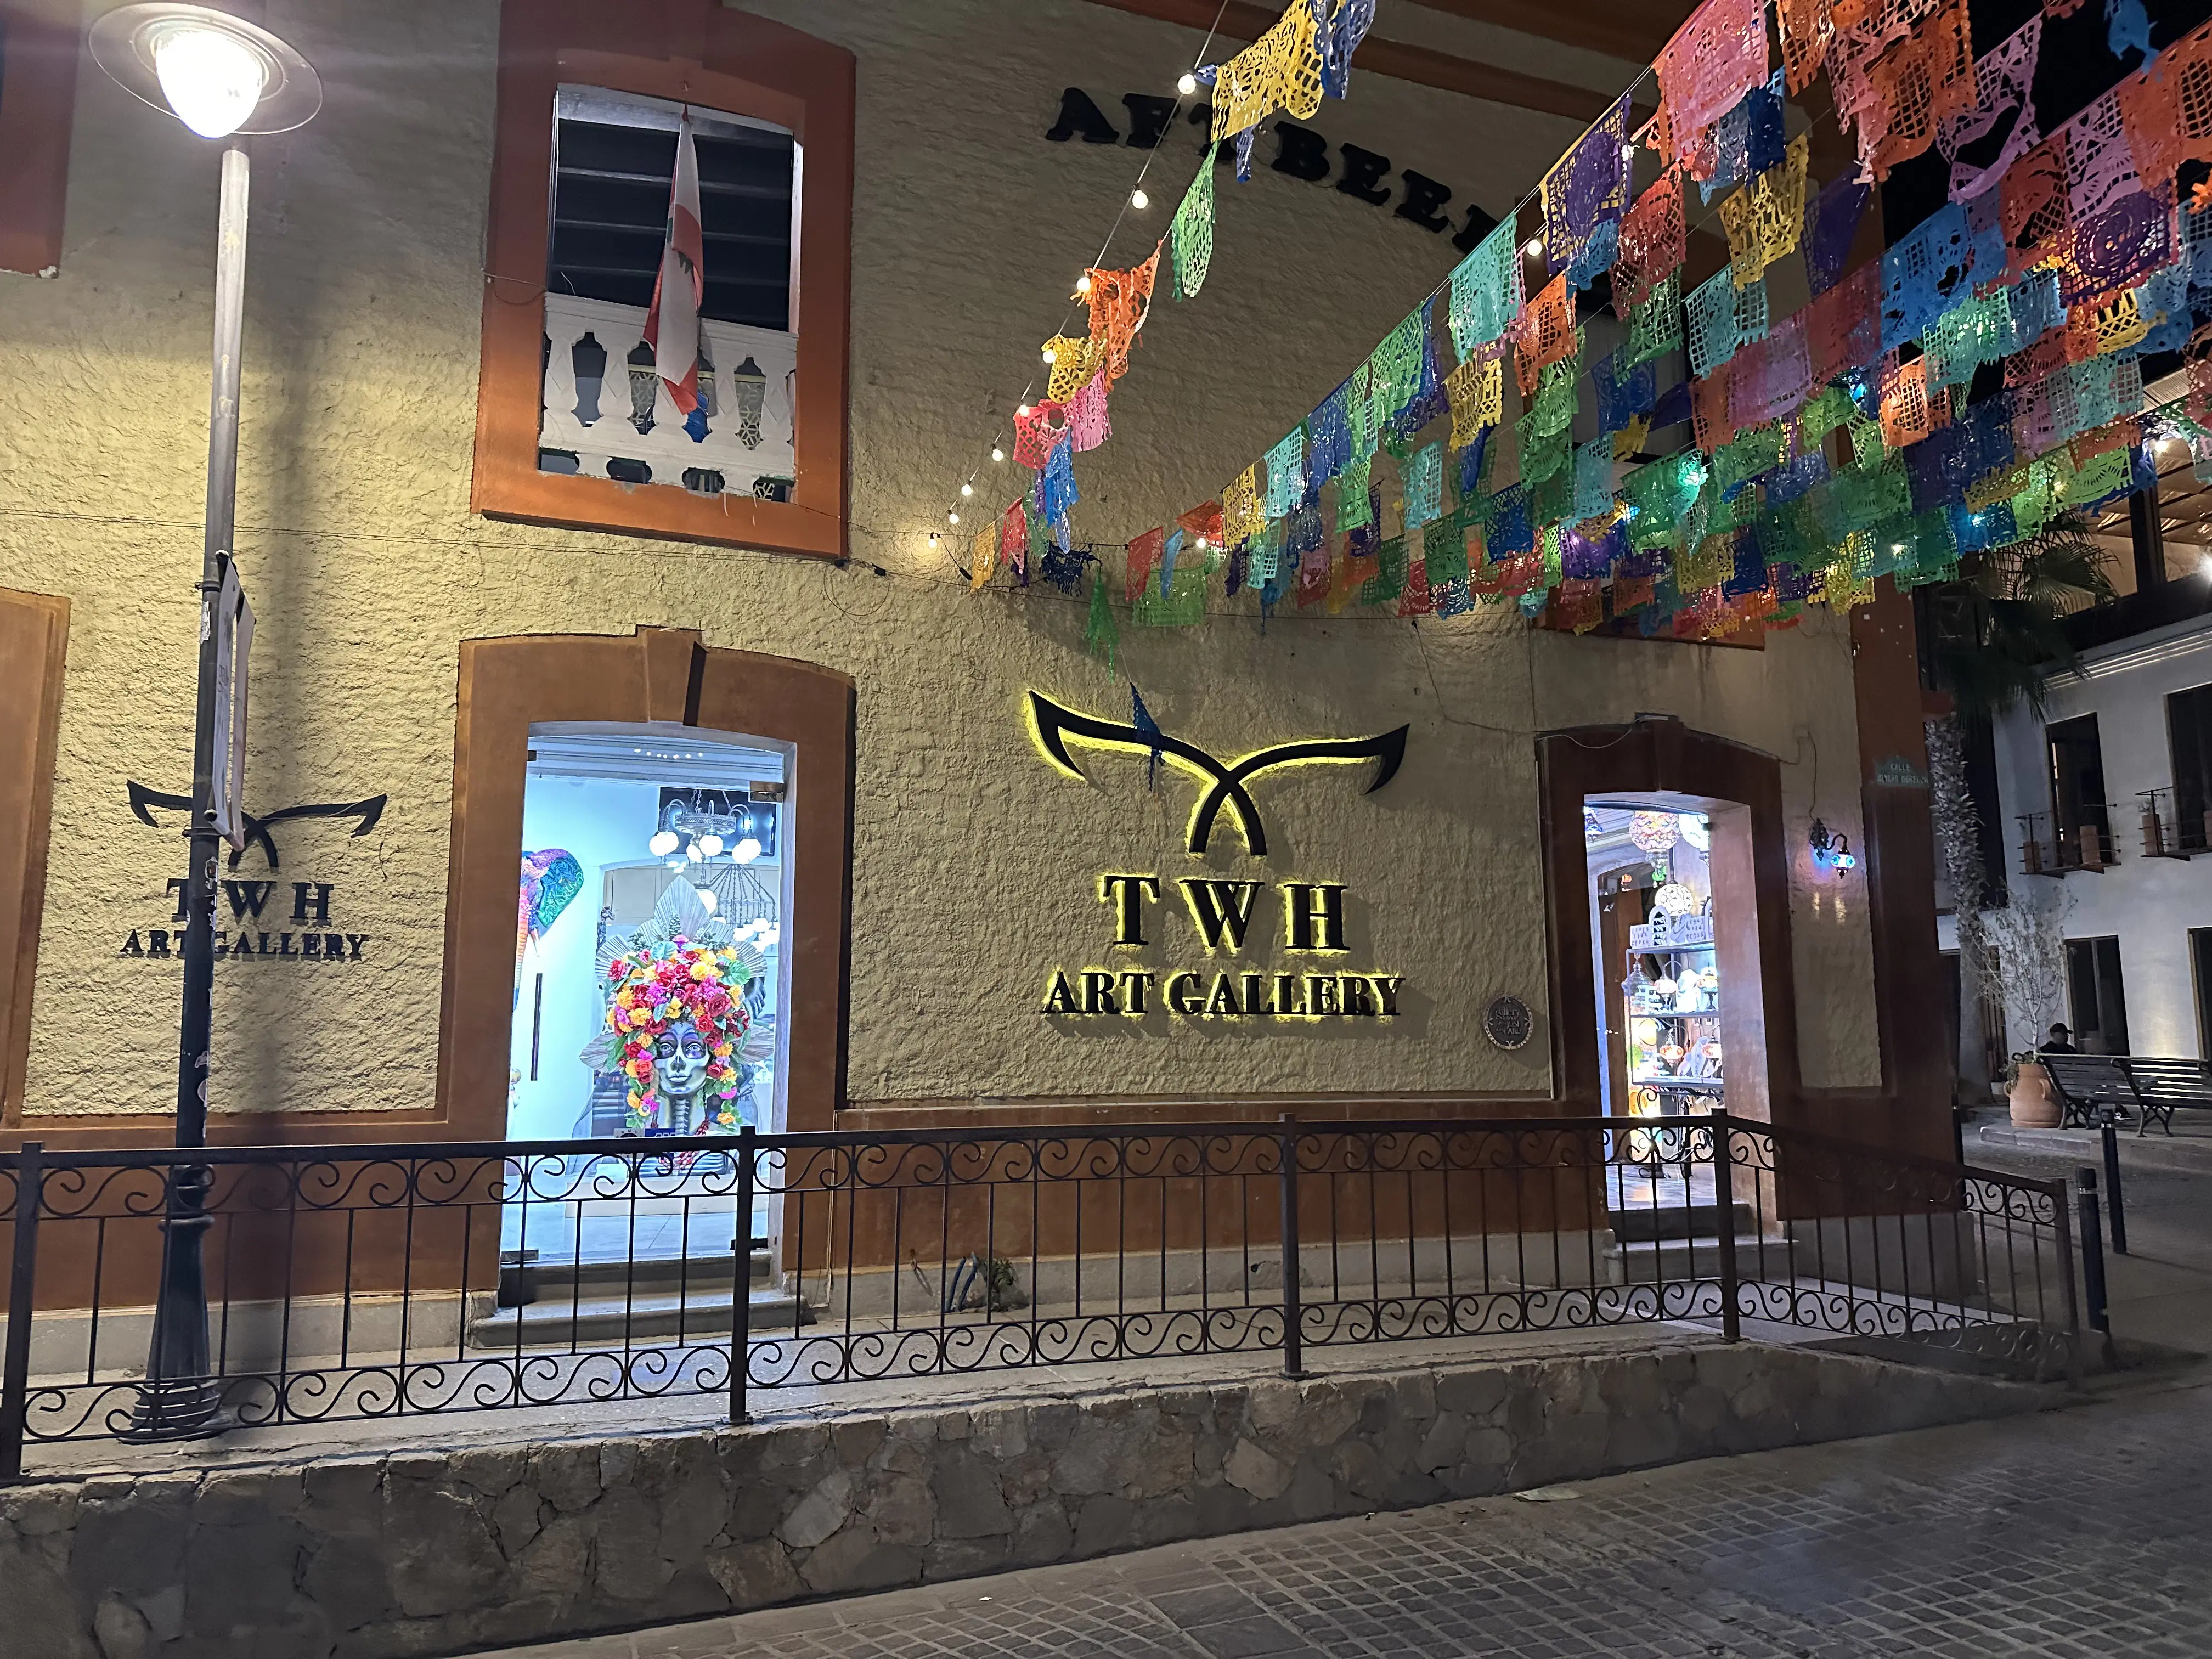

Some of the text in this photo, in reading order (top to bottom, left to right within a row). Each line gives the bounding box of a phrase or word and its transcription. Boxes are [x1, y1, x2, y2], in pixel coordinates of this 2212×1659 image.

[1890, 763, 1911, 771] CALLE
[1042, 971, 1406, 1016] ART GALLERY
